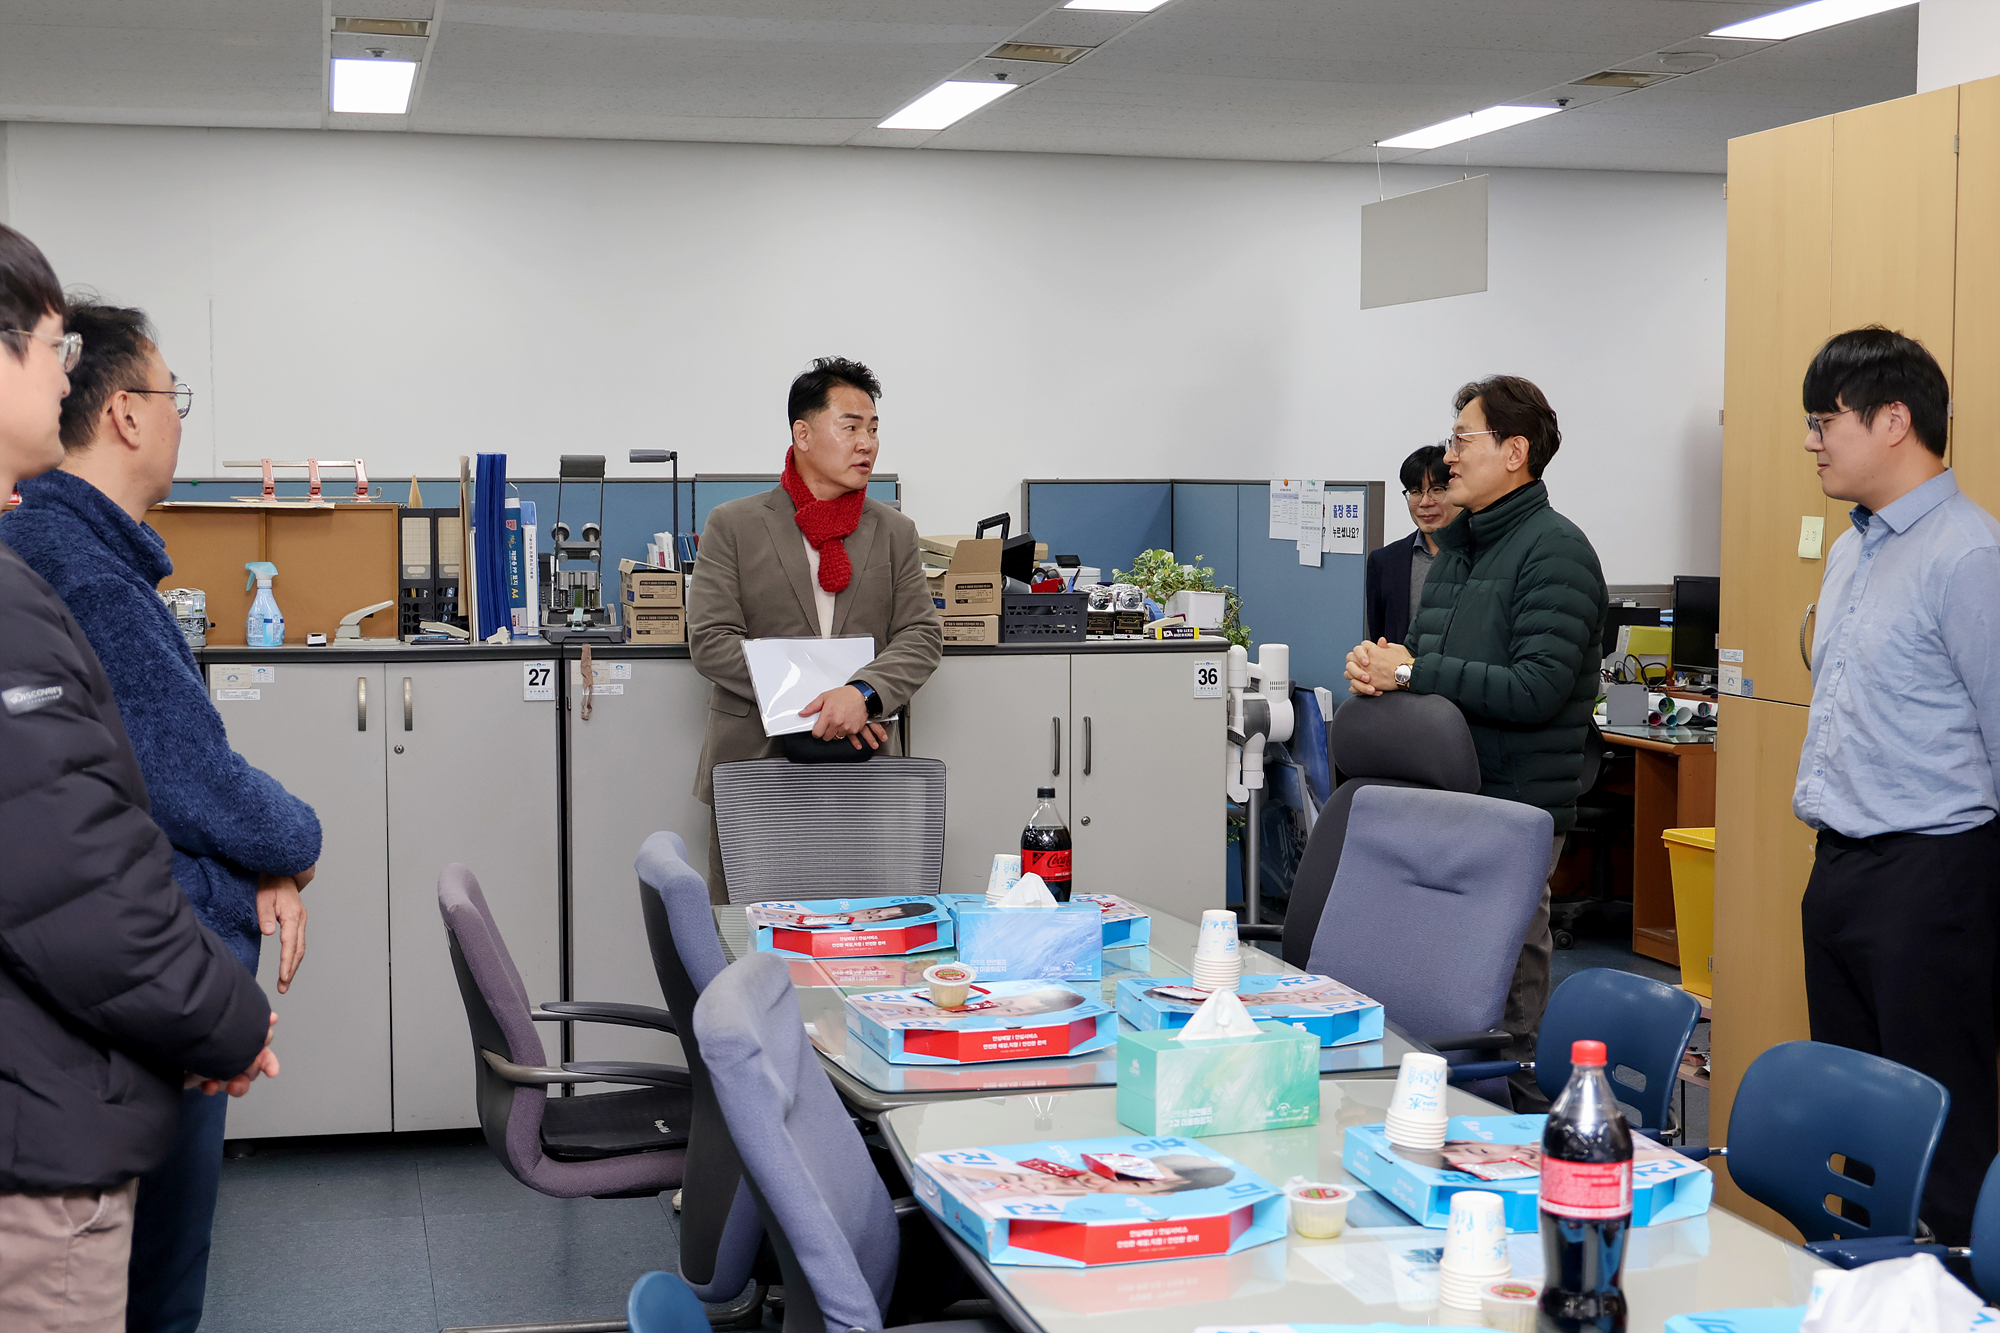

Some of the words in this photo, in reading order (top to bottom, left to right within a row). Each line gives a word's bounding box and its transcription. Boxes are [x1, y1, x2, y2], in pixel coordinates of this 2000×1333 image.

[1333, 504, 1344, 519] 출장
[1345, 504, 1359, 519] 종료
[1333, 526, 1360, 539] 누르셨나요?
[511, 588, 519, 599] A4
[528, 668, 551, 686] 27
[1198, 667, 1218, 686] 36
[14, 685, 63, 703] Discovery
[1409, 1097, 1423, 1110] 水
[937, 1152, 998, 1166] 진
[1002, 1203, 1066, 1216] 진
[1225, 1182, 1270, 1200] 미
